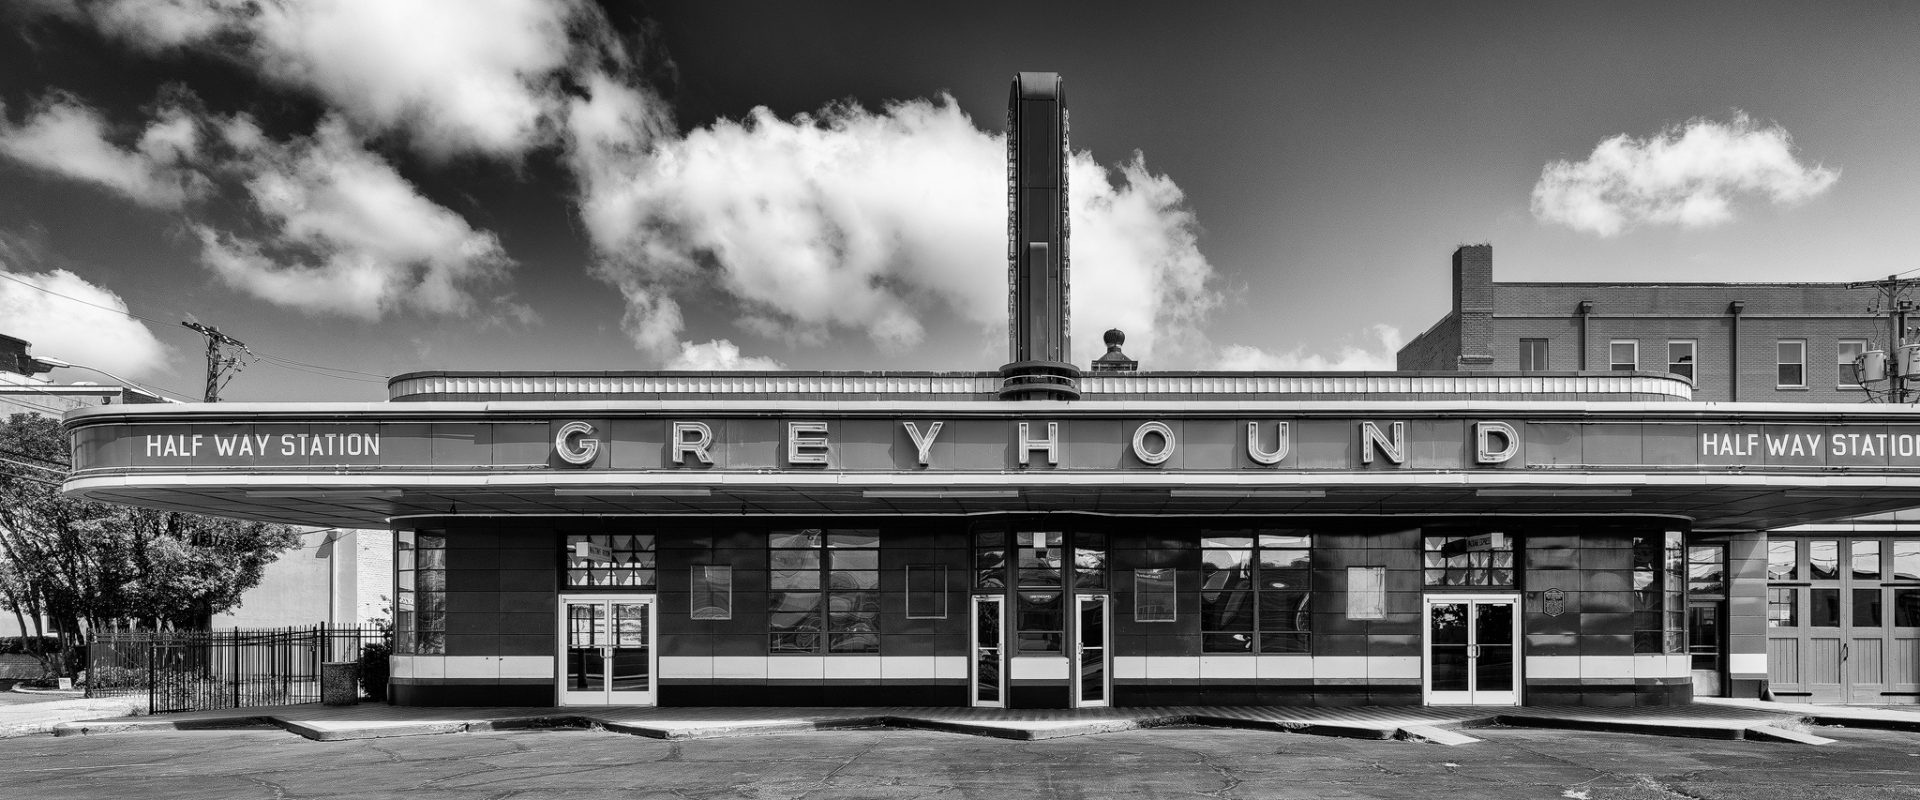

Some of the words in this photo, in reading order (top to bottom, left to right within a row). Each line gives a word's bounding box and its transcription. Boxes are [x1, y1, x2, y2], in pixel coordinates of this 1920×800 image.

[146, 434, 203, 457] HALF
[214, 433, 271, 456] WAY
[281, 433, 380, 456] STATION
[555, 420, 1520, 464] GREYHOUND
[1702, 432, 1759, 456] HALF
[1765, 433, 1821, 456] WAY
